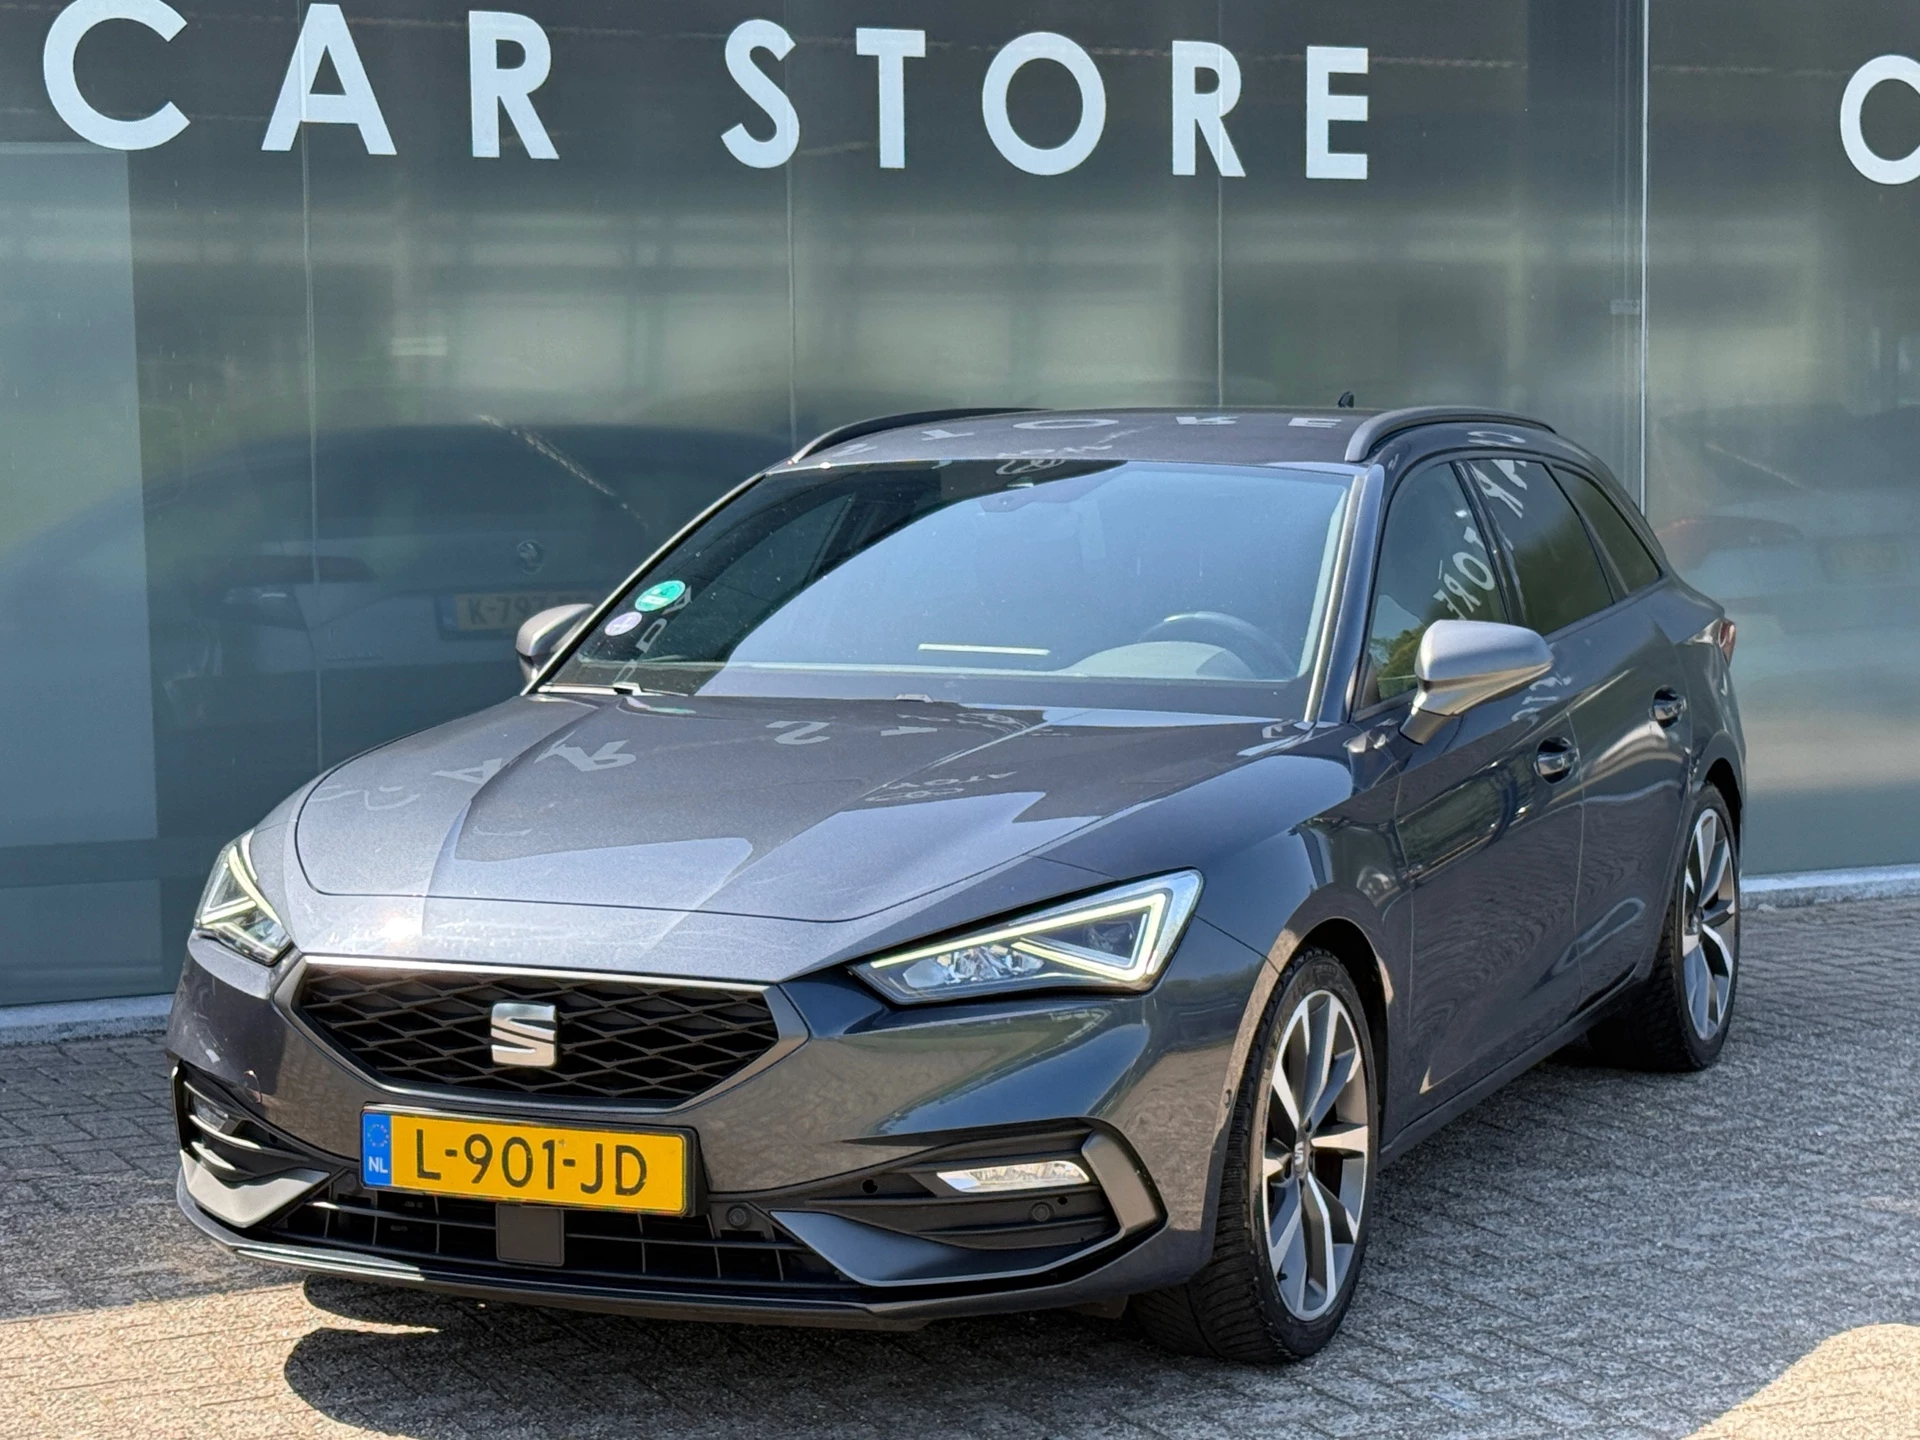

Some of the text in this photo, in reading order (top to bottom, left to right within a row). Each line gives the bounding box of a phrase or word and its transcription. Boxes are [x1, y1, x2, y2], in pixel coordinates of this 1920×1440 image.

[43, 0, 1368, 180] CAR STORE
[368, 1128, 648, 1197] NL L-901-JD
